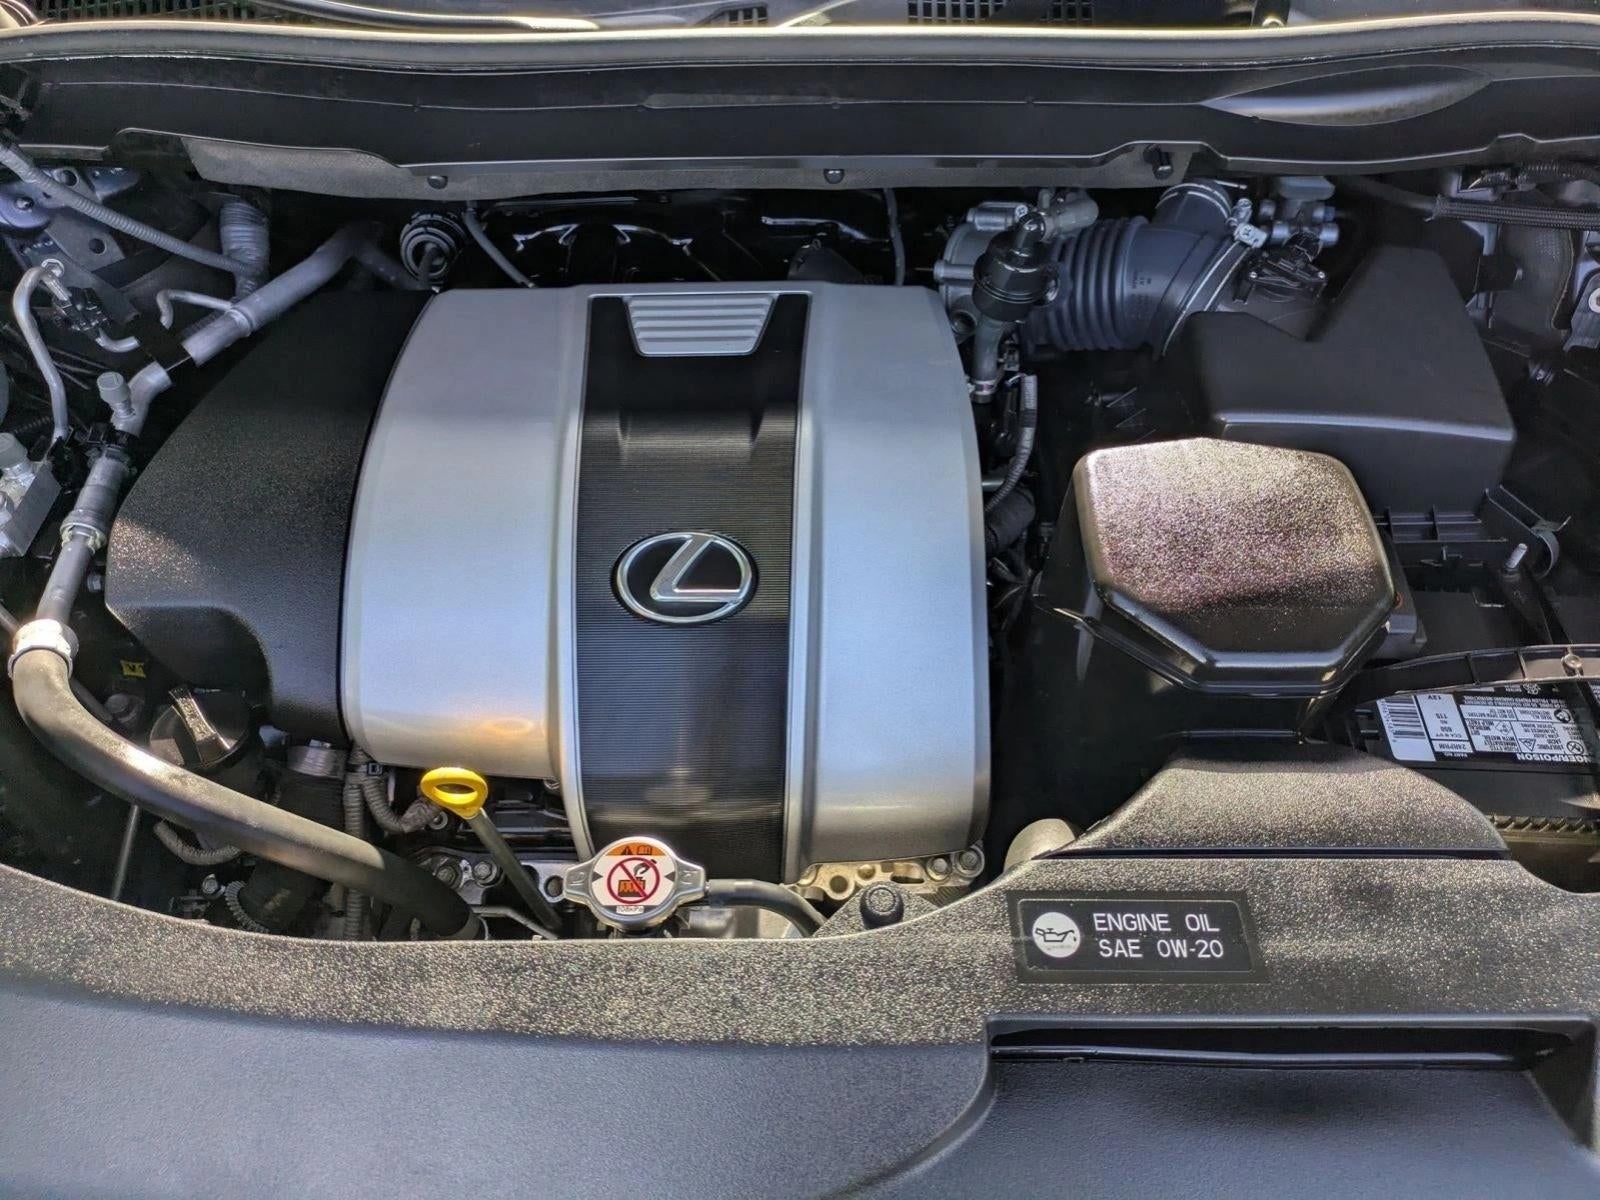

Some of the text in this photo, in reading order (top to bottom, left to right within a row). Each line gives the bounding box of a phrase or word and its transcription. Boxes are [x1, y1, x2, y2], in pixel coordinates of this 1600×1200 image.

[1092, 912, 1220, 932] ENGINE OIL
[1098, 939, 1224, 958] SAE 0W-20
